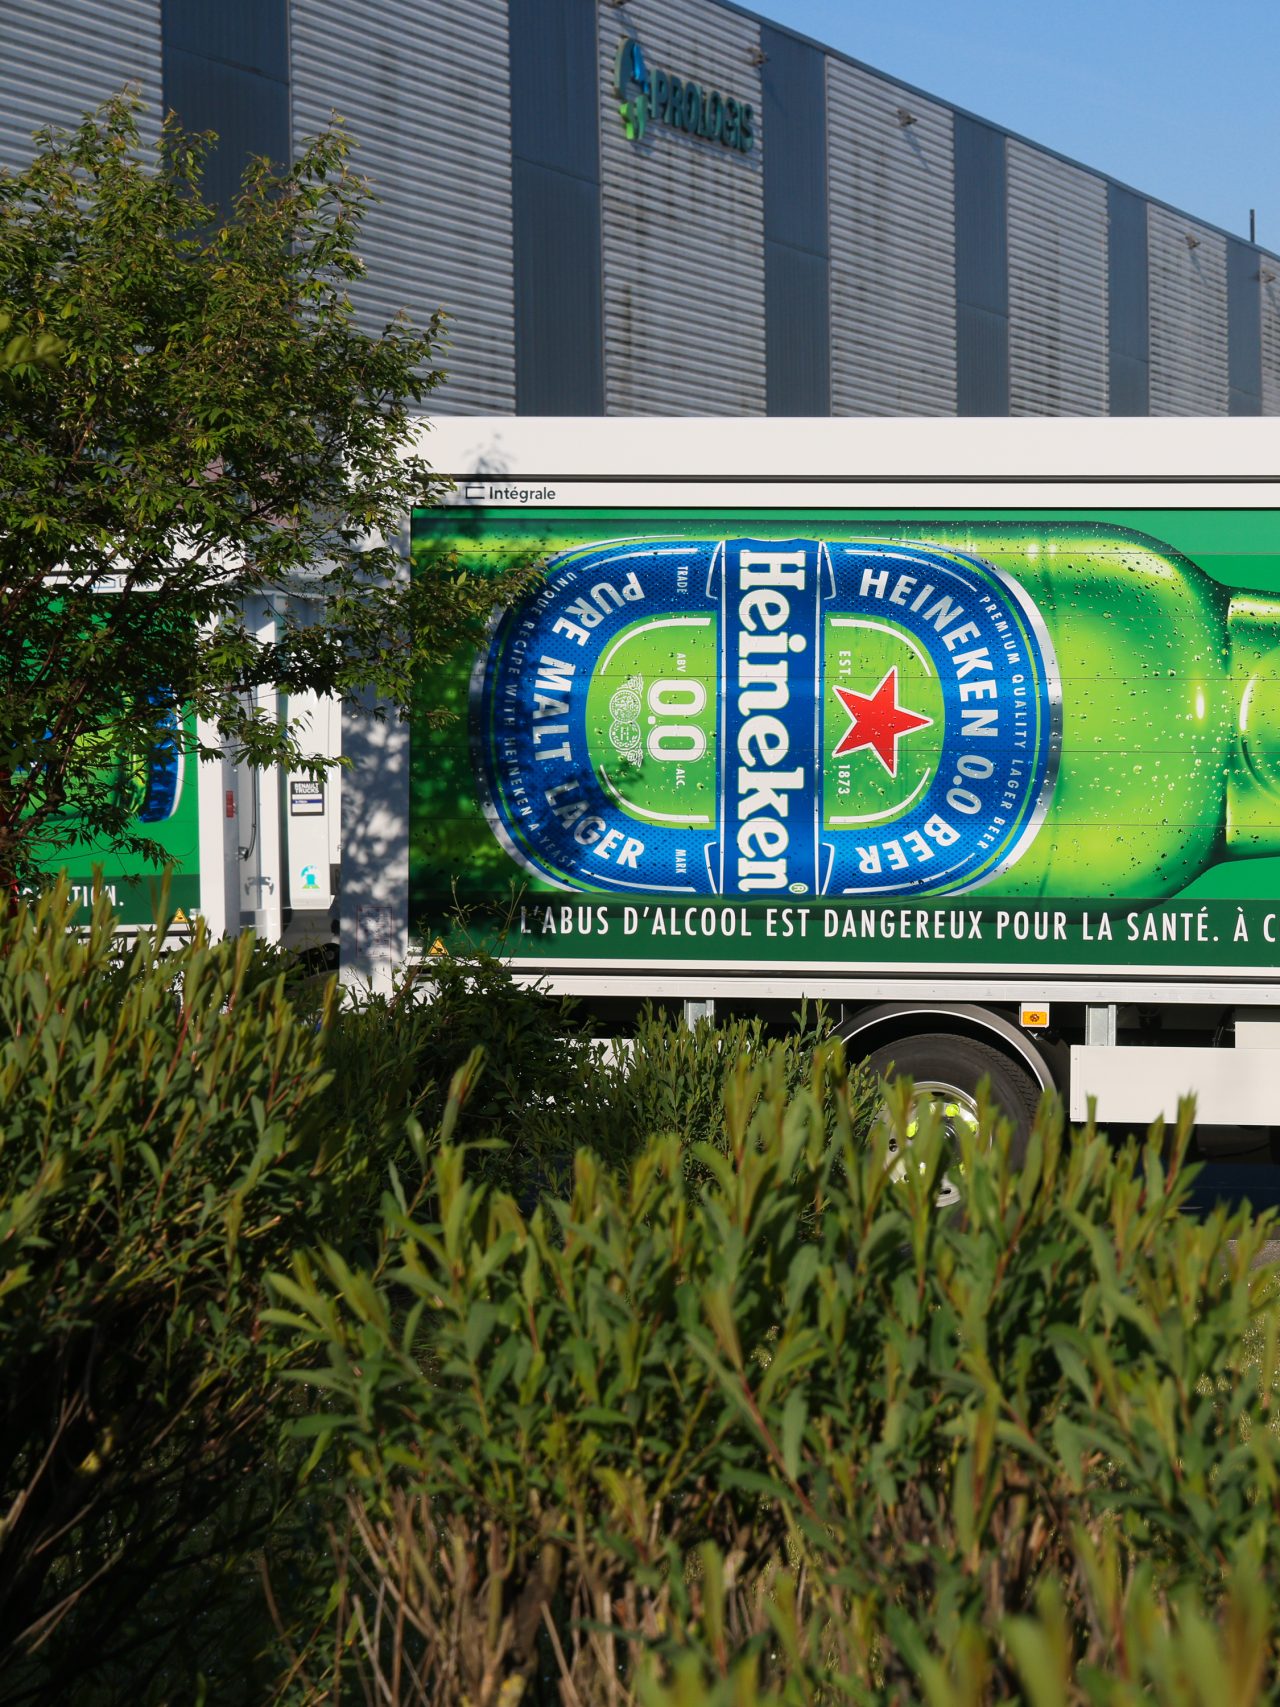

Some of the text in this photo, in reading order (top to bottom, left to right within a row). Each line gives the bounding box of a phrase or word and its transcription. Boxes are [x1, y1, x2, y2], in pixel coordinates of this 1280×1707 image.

[650, 68, 754, 152] PROLOGIS
[489, 486, 556, 503] Intégrale
[676, 566, 689, 595] TRADE
[676, 652, 687, 673] ABV
[838, 650, 851, 680] EST.
[503, 572, 577, 868] UNIQUE RECIPE WITH HEINEKEN A-YEAST
[533, 572, 645, 869] PURE MALT LAGER
[647, 678, 706, 763] 0.0
[855, 568, 998, 874] HEINEKEN 0.0 BEER
[976, 596, 1027, 849] PREMIUM QUALITY LAGER BEER
[675, 768, 686, 789] ALC.
[838, 764, 851, 795] 1873
[675, 849, 687, 874] MARK
[520, 905, 609, 935] L'ABUS
[624, 906, 752, 937] D'ALCOOL
[766, 908, 811, 937] EST
[824, 908, 983, 940] DANGEREUX
[996, 910, 1068, 941] POUR
[1082, 912, 1113, 941] LA
[1126, 906, 1219, 942] SANTÉ.
[1233, 906, 1250, 942] À
